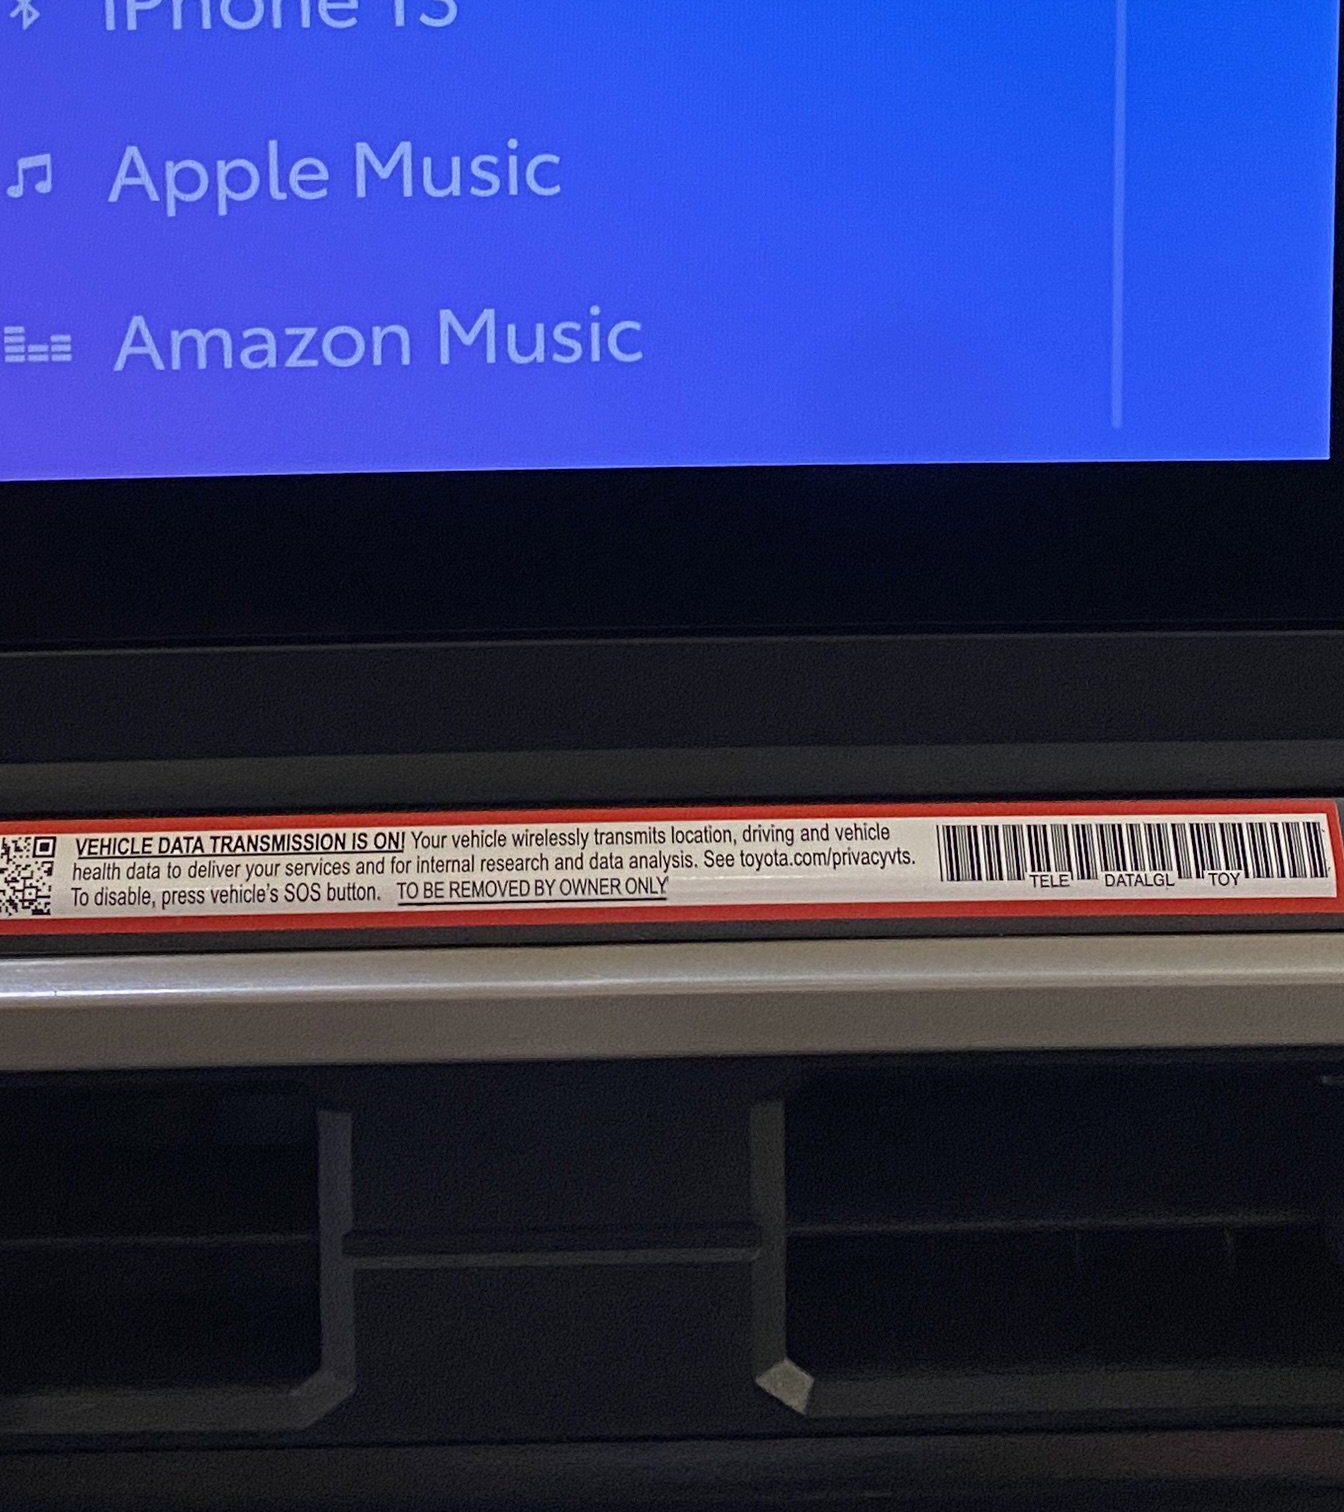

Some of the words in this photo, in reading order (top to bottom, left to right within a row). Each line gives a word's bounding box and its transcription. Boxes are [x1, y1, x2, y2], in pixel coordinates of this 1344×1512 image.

[106, 139, 331, 218] Apple
[355, 137, 562, 199] Music
[113, 314, 411, 372] Amazon
[438, 303, 644, 366] Music
[75, 836, 153, 857] VEHICLE
[158, 835, 205, 855] DATA
[209, 832, 347, 854] TRANSMISSION
[352, 832, 368, 851] IS
[373, 831, 405, 851] ON!
[411, 830, 448, 850] Your
[451, 828, 507, 849] vehicle
[511, 827, 590, 850] wirelessly
[594, 825, 666, 846] transmits
[670, 825, 738, 846] location,
[742, 824, 795, 846] driving
[800, 823, 830, 842] and
[834, 821, 891, 841] vehicle
[72, 861, 121, 882] health
[126, 861, 161, 880] data
[166, 862, 182, 880] to
[187, 859, 241, 879] deliver
[245, 862, 281, 882] your
[284, 857, 351, 877] services
[355, 856, 385, 875] and
[390, 855, 412, 874] for
[416, 854, 475, 874] internal
[480, 852, 549, 872] research
[554, 851, 584, 871] and
[589, 851, 624, 870] data
[628, 850, 699, 873] analysis.
[703, 849, 735, 868] See
[739, 846, 916, 871] toyota.com/privacyvts.
[1028, 873, 1070, 888] TELE
[1104, 871, 1176, 888] DATALGL
[1207, 871, 1241, 888] TOY
[71, 887, 90, 907] To
[94, 886, 156, 908] disable,
[161, 888, 206, 910] press
[209, 883, 280, 905] vehicle's
[283, 881, 322, 903] SOS
[327, 881, 382, 902] button.
[396, 881, 420, 900] TO
[423, 880, 445, 899] BE
[449, 878, 531, 899] REMOVED
[534, 878, 556, 897] BY
[559, 877, 623, 897] OWNER
[625, 875, 669, 895] ONLY
